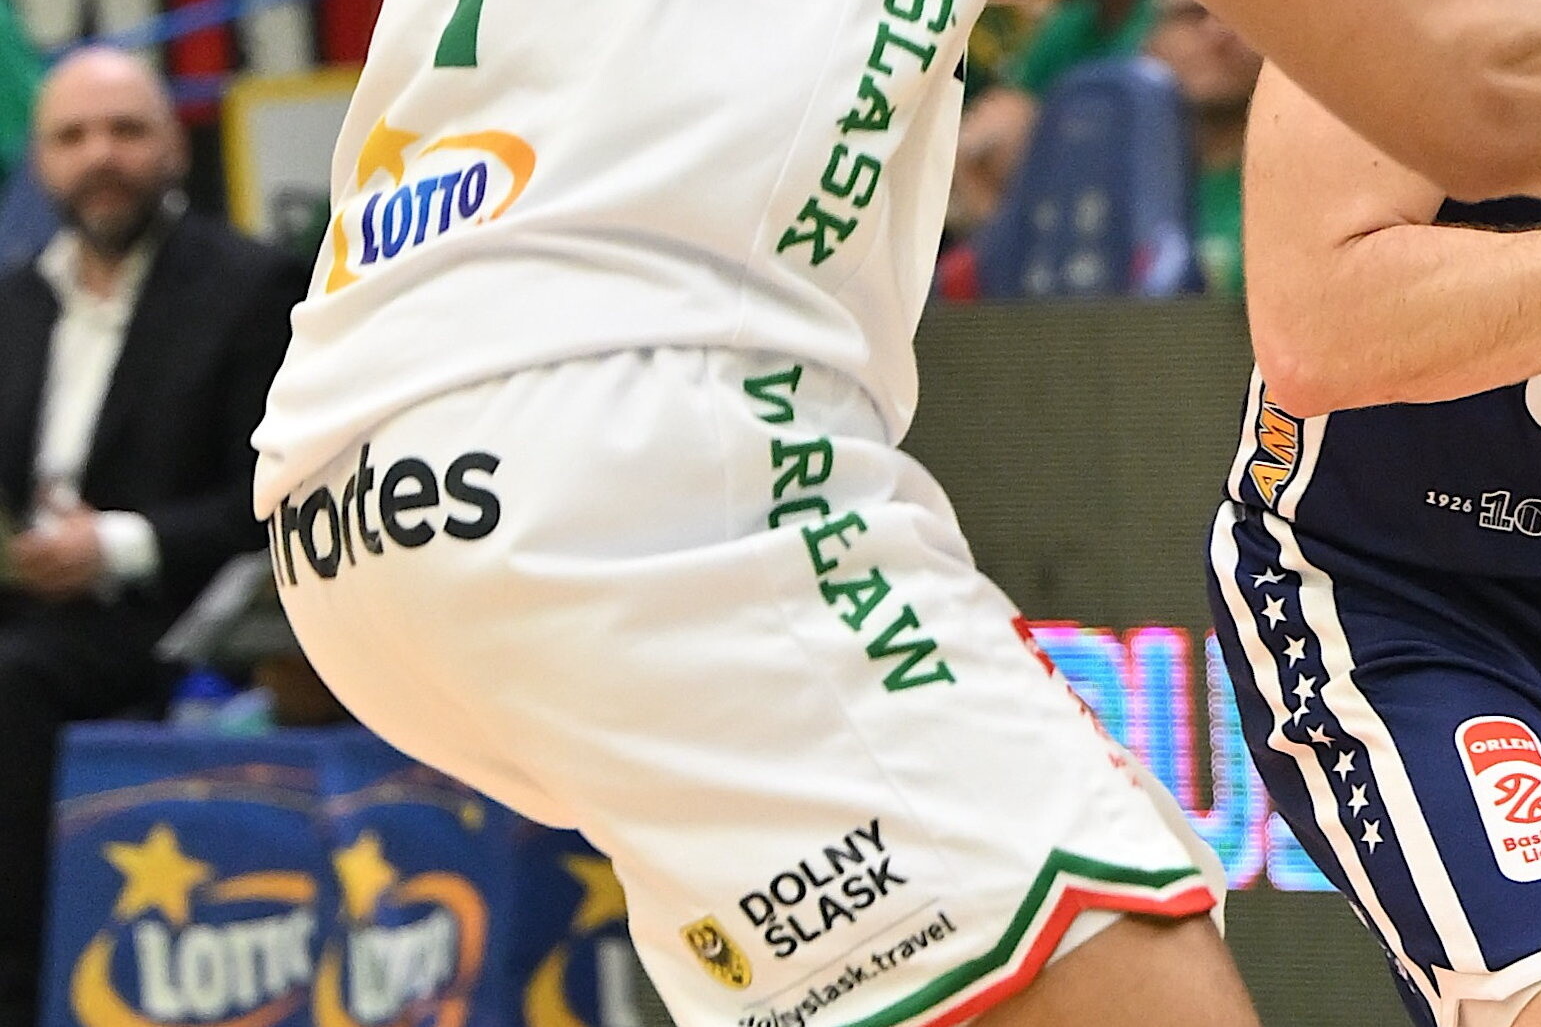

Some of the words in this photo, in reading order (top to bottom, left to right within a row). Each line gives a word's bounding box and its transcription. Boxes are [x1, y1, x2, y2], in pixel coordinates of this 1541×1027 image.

[360, 161, 488, 266] LOTTO
[1426, 491, 1473, 513] 1926
[1470, 738, 1537, 754] ORLEN
[739, 818, 885, 927] DOLNY
